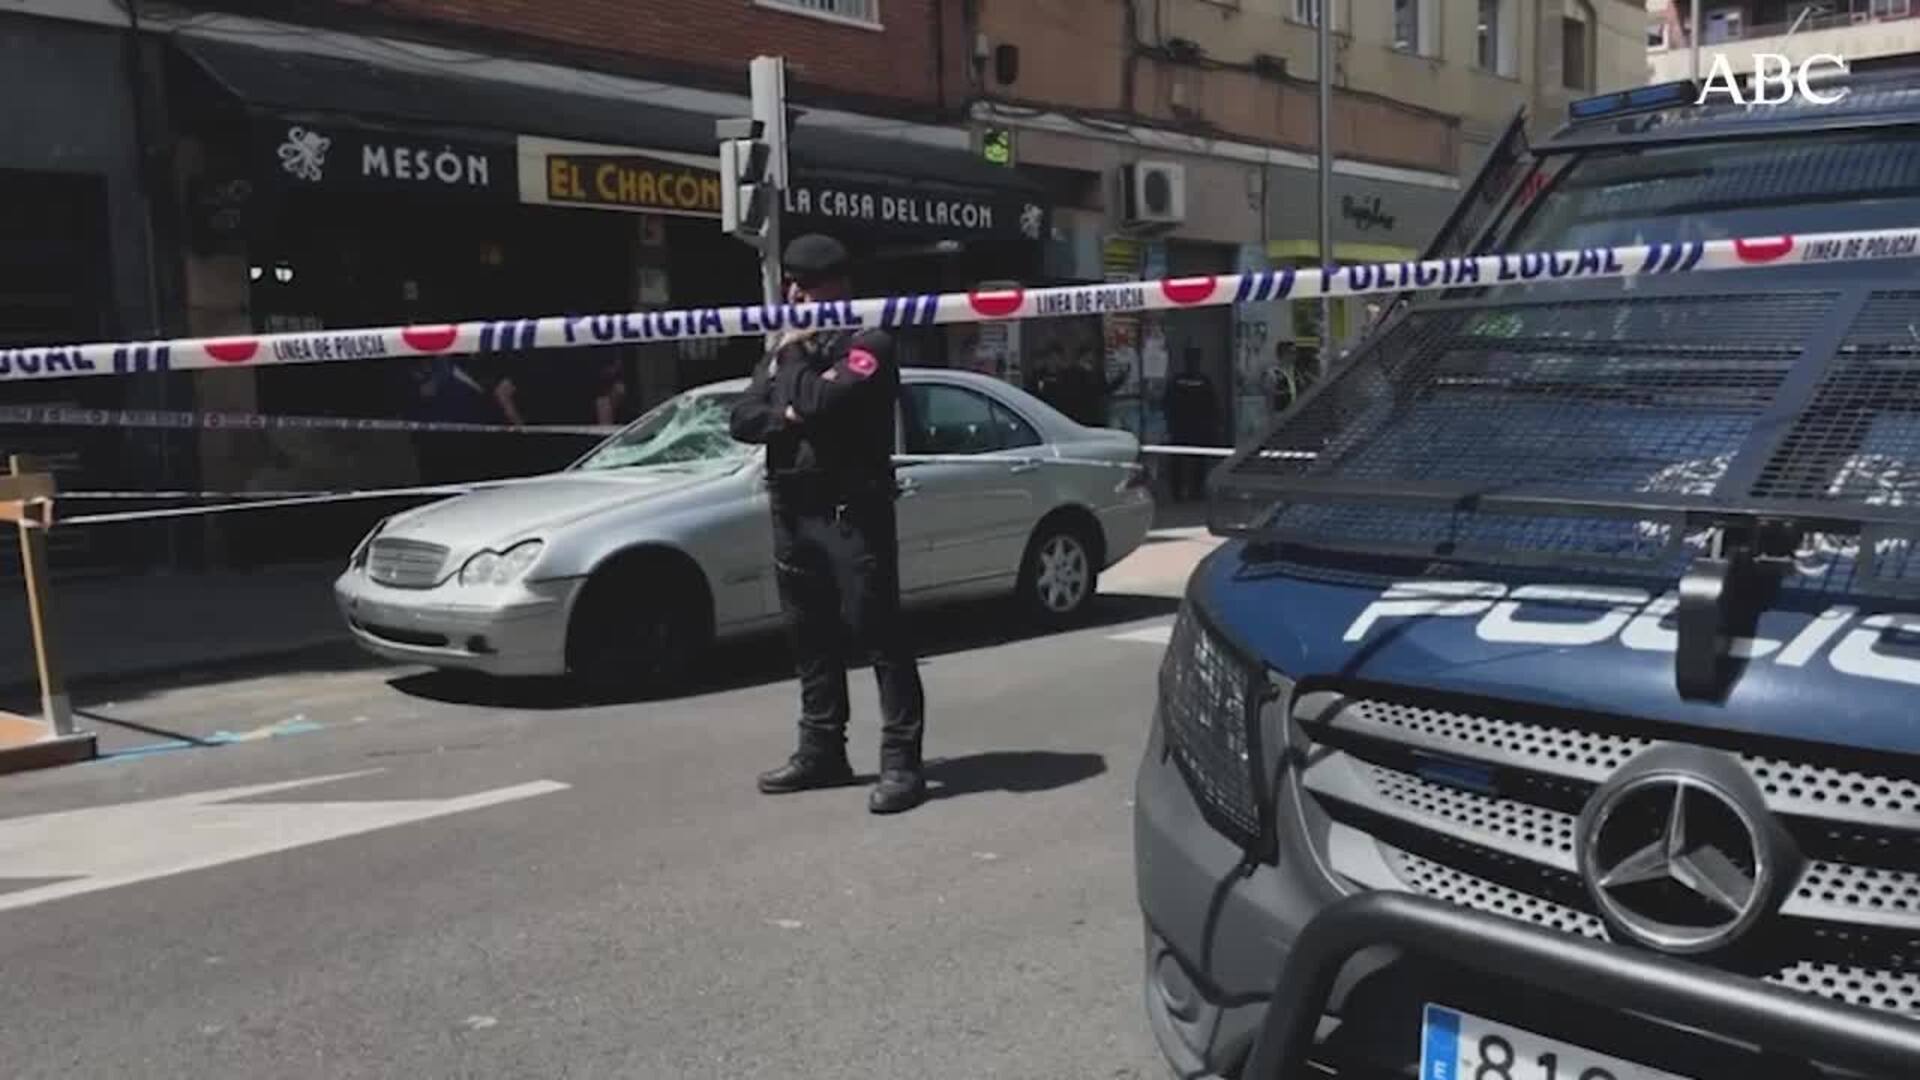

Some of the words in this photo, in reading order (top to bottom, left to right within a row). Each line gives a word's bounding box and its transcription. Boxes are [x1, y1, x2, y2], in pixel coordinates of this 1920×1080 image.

[362, 144, 489, 186] MESÓN
[551, 158, 587, 198] EL
[784, 188, 811, 214] LA
[819, 190, 874, 219] CASA
[881, 196, 920, 223] DEL
[1843, 238, 1864, 257] DE
[1075, 291, 1093, 312] DE
[313, 338, 333, 359] DE
